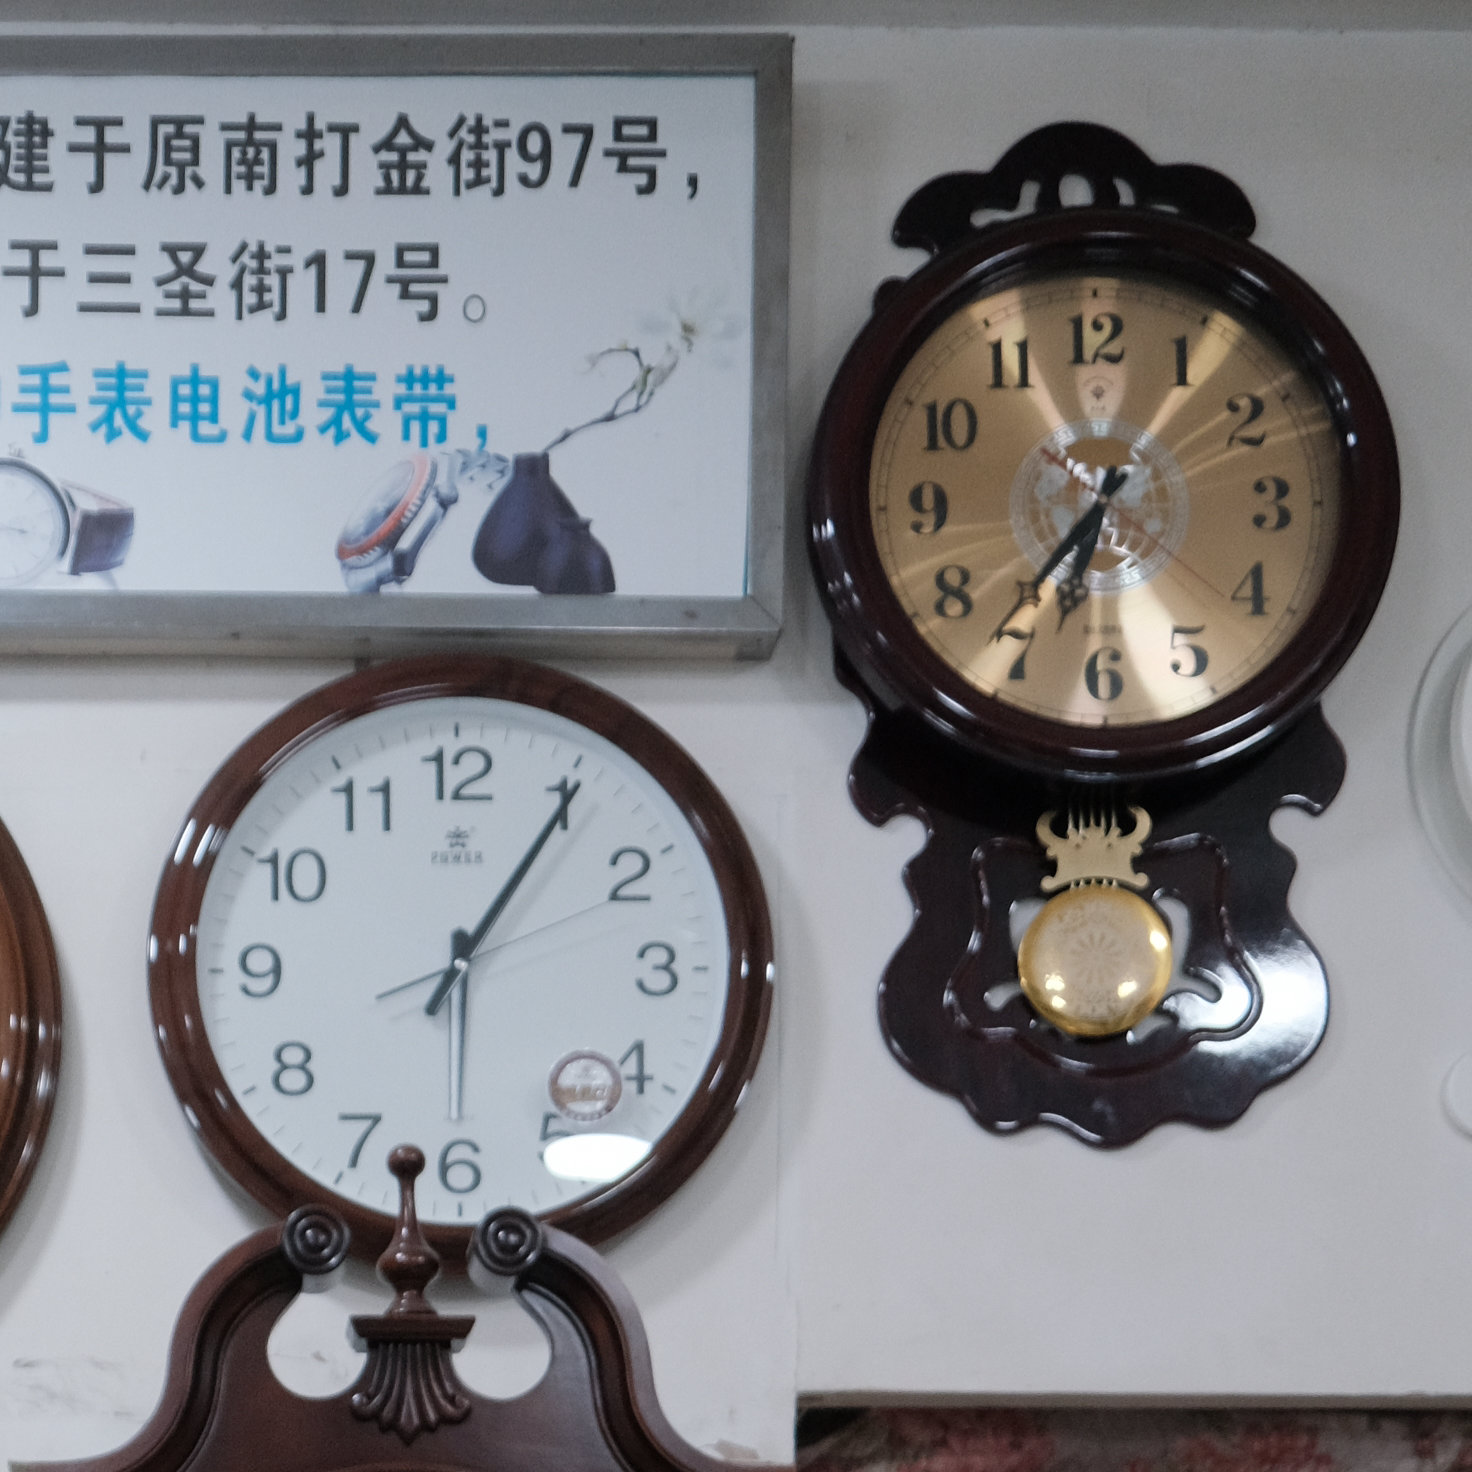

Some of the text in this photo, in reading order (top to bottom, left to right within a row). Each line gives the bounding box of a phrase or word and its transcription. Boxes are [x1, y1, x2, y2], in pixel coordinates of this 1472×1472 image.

[988, 336, 1035, 389] 11
[1068, 312, 1126, 366] 12
[1170, 335, 1196, 387] 1
[922, 398, 979, 452] 10
[1226, 393, 1266, 448] 2
[909, 481, 949, 536] 9
[1252, 476, 1292, 531] 3
[934, 565, 974, 619] 8
[1231, 562, 1271, 617] 4
[1084, 647, 1125, 701] 6
[1170, 625, 1210, 678] 5
[422, 746, 495, 802] 12
[331, 776, 392, 833] 11
[256, 848, 328, 904] 10
[608, 846, 653, 902] 2
[238, 943, 283, 999] 9
[635, 941, 679, 997] 3
[272, 1041, 316, 1098] 8
[338, 1113, 383, 1170] 7
[437, 1139, 483, 1194] 6
